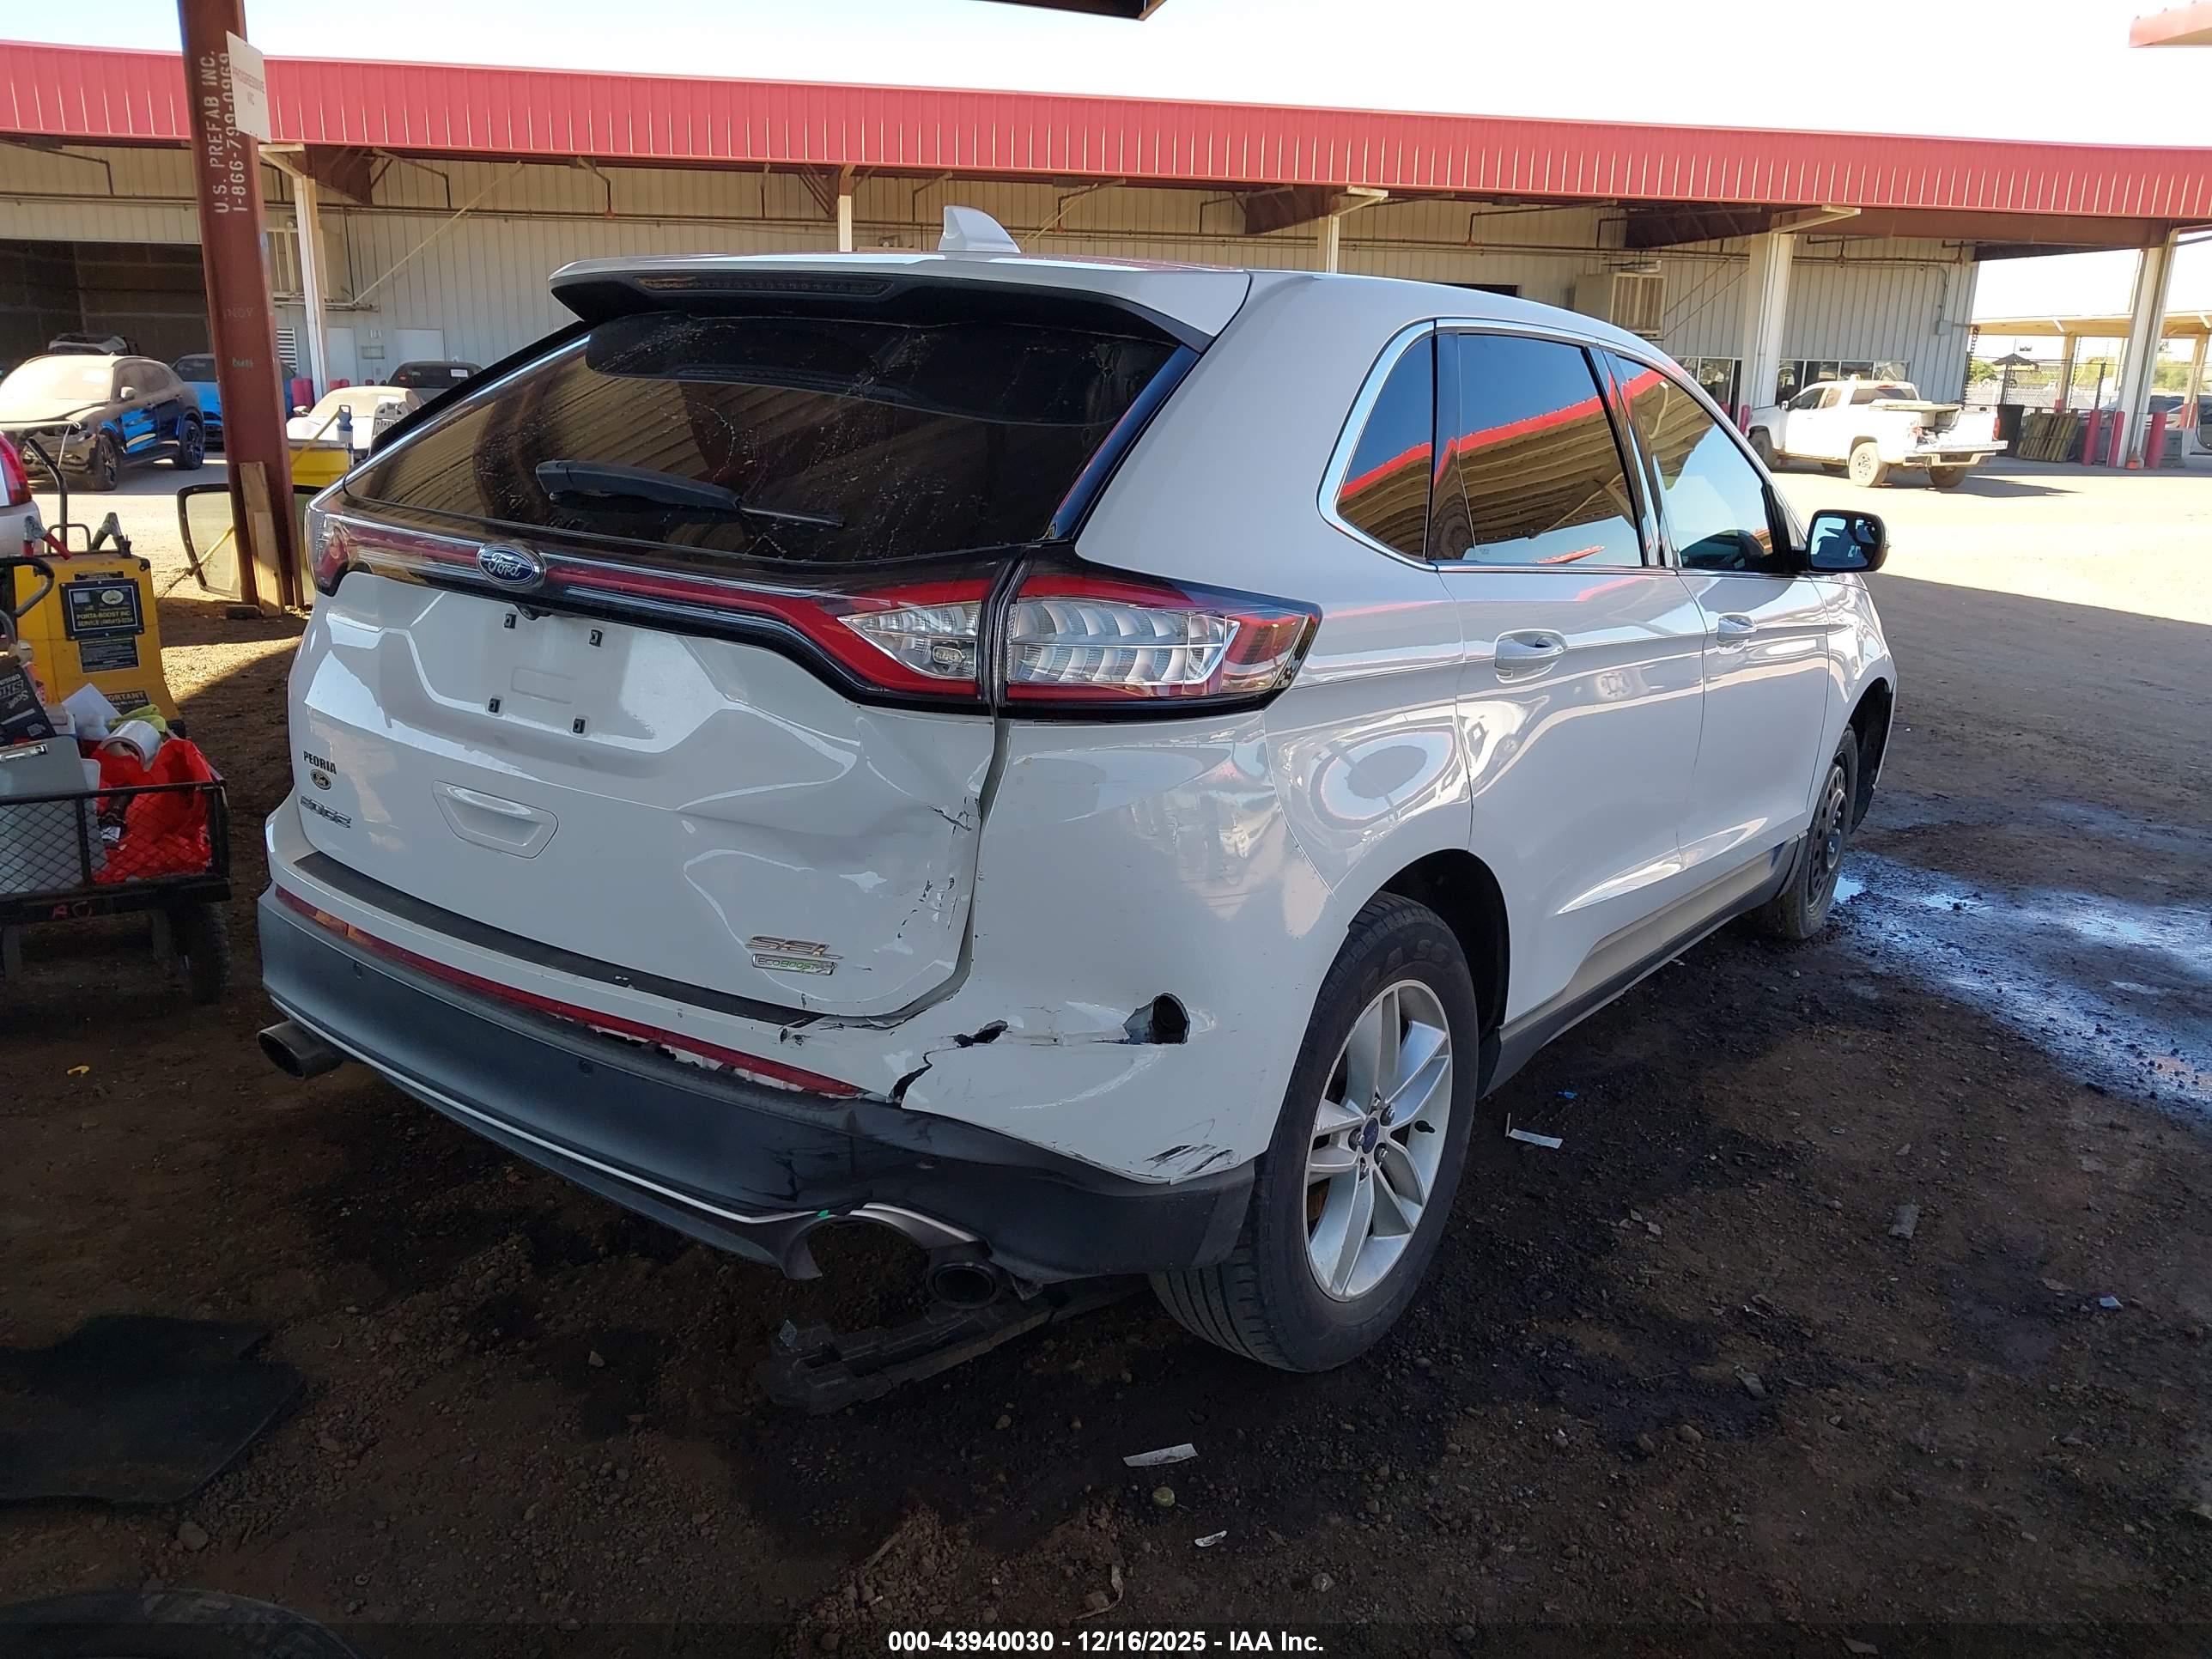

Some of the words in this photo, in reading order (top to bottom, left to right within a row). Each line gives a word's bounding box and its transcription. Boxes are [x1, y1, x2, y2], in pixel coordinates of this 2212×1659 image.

[200, 50, 218, 87] INC.
[204, 95, 225, 168] PREFAB
[212, 179, 230, 214] U.S.
[488, 552, 521, 577] Ford
[108, 690, 145, 702] ORTANT
[303, 750, 337, 775] PEORIA
[300, 794, 352, 830] EDGE
